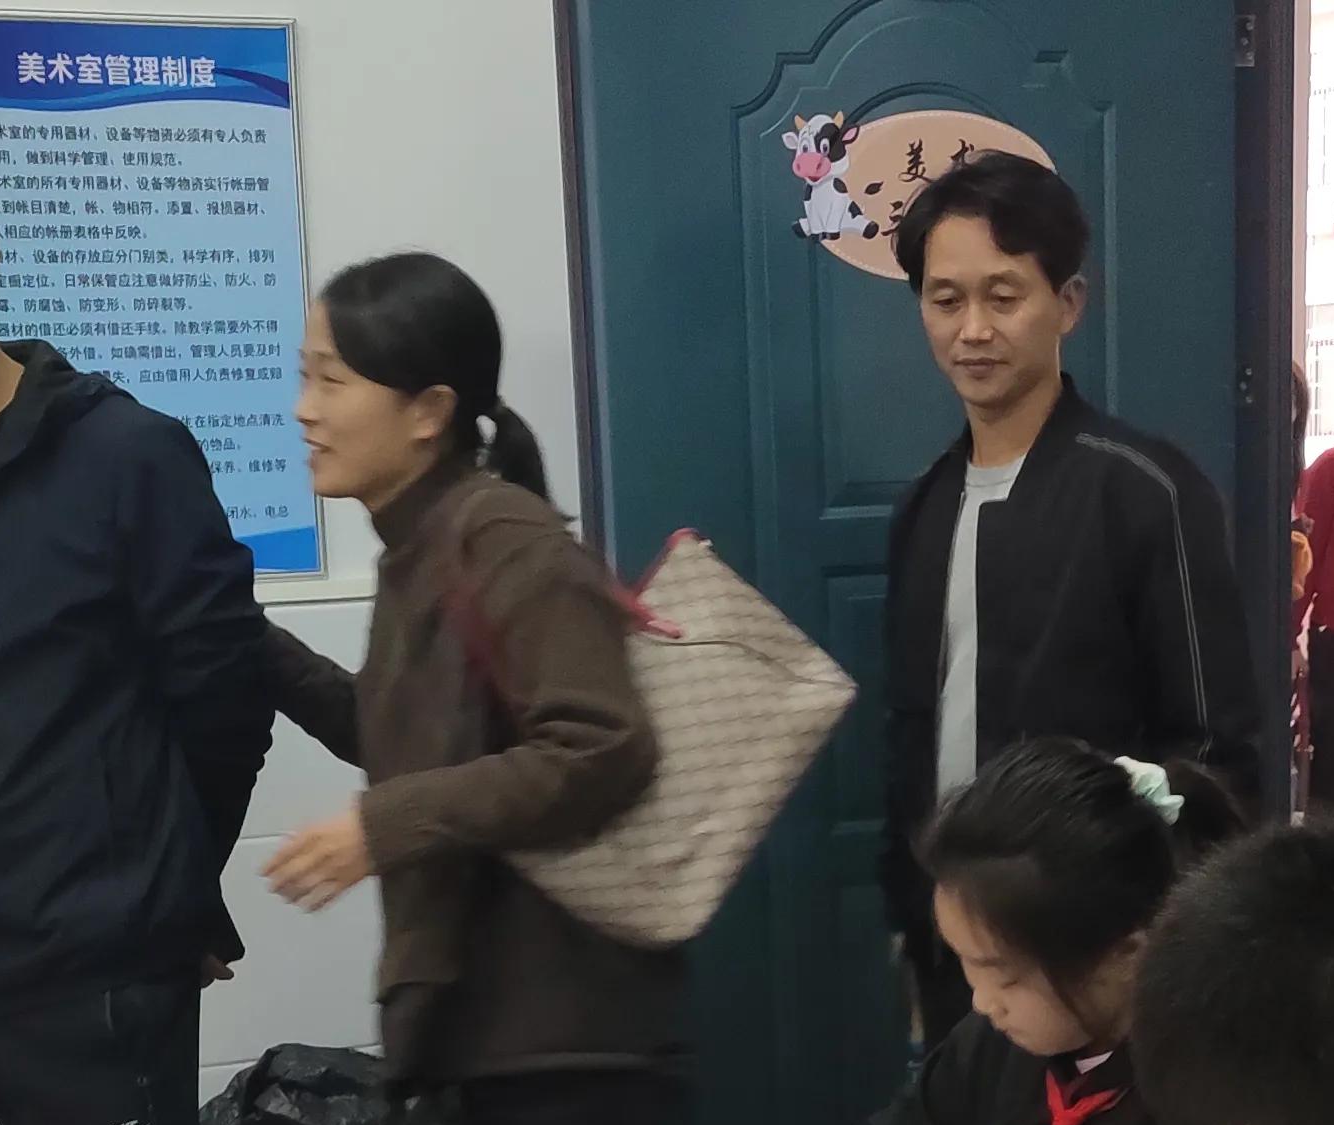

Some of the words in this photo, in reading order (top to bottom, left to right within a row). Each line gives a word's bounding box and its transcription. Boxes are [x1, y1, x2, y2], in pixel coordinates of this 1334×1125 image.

[17, 52, 216, 88] 美术室管理制度
